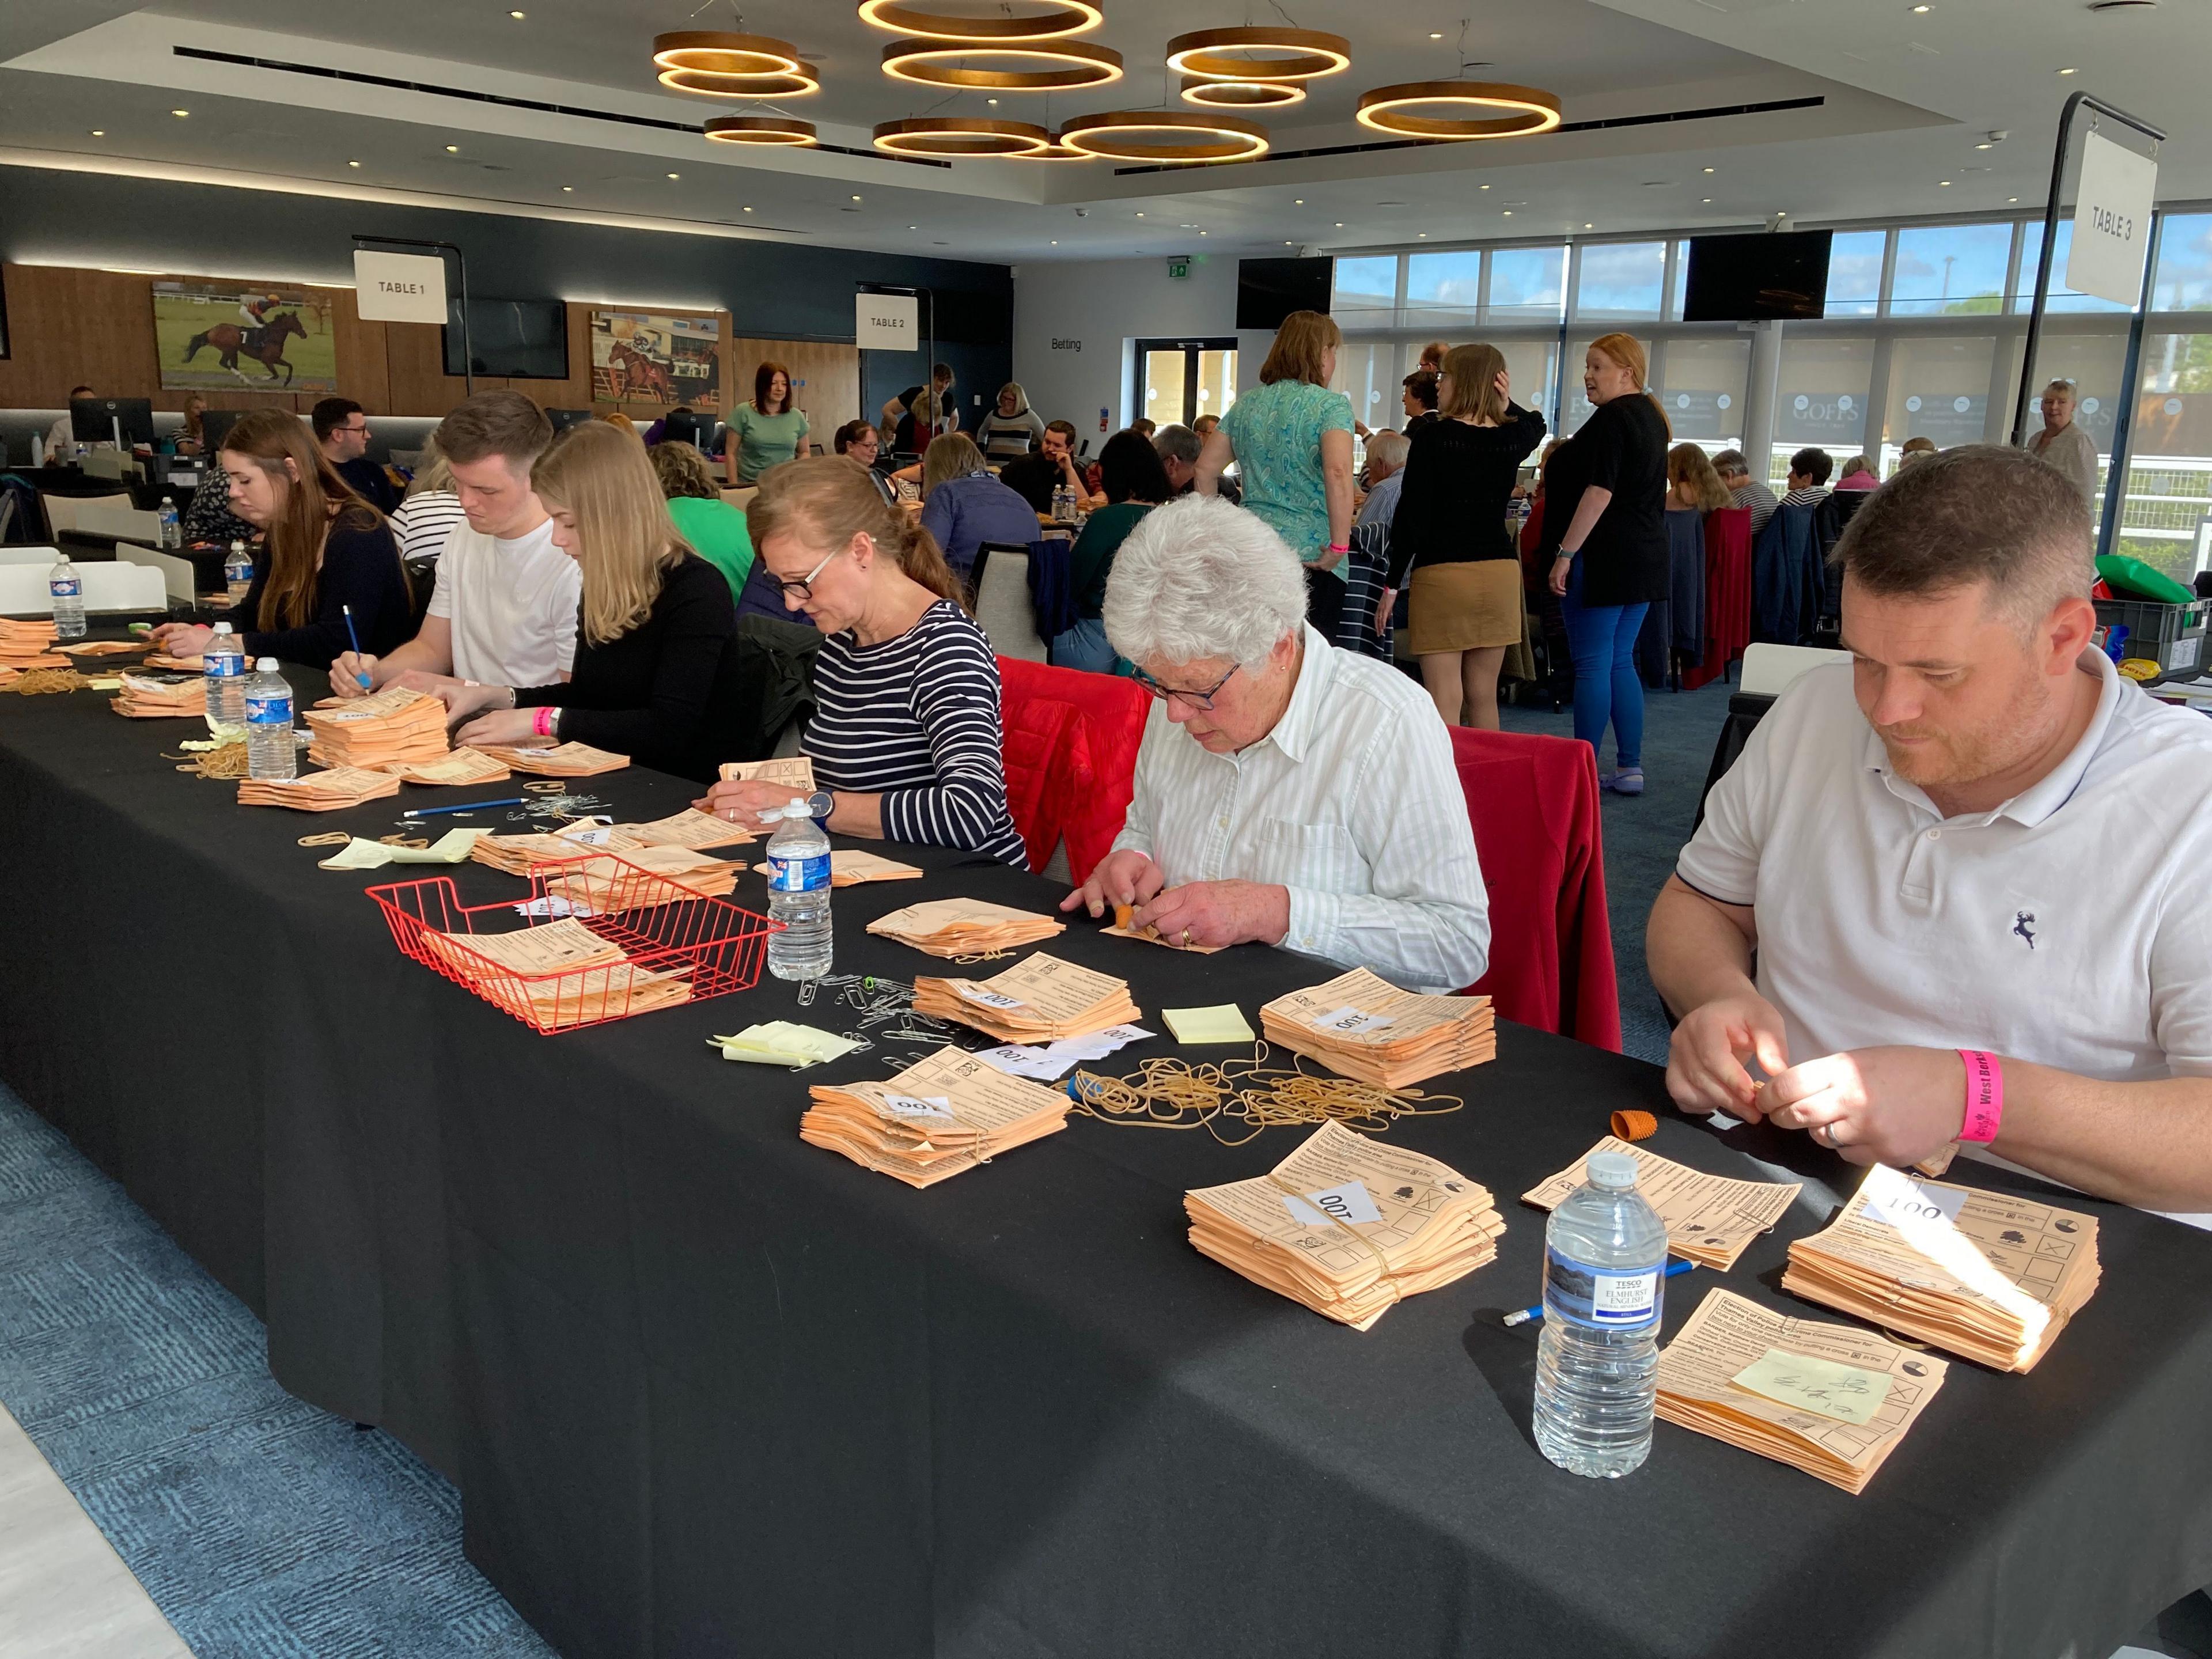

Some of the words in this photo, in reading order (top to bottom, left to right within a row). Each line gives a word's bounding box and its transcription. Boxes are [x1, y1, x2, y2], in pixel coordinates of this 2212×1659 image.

[2093, 206, 2123, 237] TABLE
[2125, 219, 2132, 240] 3
[378, 282, 416, 294] TABLE
[420, 285, 424, 294] 1
[871, 318, 897, 327] TABLE
[899, 319, 904, 327] 2
[1052, 338, 1081, 352] Betting
[984, 994, 1017, 1006] 100
[1103, 1029, 1134, 1039] 100
[995, 1050, 1030, 1062] 100
[1980, 1078, 1991, 1104] West
[1320, 1137, 1331, 1146] Vote
[1326, 1131, 1344, 1145] Thames
[1315, 1141, 1324, 1150] box
[1331, 1127, 1350, 1141] Election
[1392, 1152, 1425, 1164] Commissioner
[1319, 1195, 1353, 1218] 100
[1968, 1192, 2016, 1207] Commissioner
[1888, 1198, 1941, 1219] 100
[1861, 1222, 1889, 1235] Democrats
[1606, 1289, 1649, 1298] ELMHURST
[1611, 1296, 1643, 1305] ENGLISH
[1719, 1304, 1745, 1320] Thames
[1745, 1316, 1766, 1328] Valley
[1765, 1325, 1785, 1335] police
[1723, 1298, 1749, 1316] Election
[1758, 1316, 1778, 1328] Police
[1792, 1328, 1812, 1336] Crime
[1812, 1332, 1862, 1346] Commissioner
[1703, 1320, 1727, 1335] BARBER,
[1728, 1331, 1750, 1343] Matthew
[1749, 1339, 1767, 1348] David
[1710, 1314, 1723, 1324] box
[1722, 1320, 1737, 1330] next
[1744, 1328, 1758, 1338] your
[1758, 1334, 1779, 1344] choice
[1714, 1309, 1730, 1320] Vote
[1729, 1315, 1738, 1323] for
[1737, 1319, 1751, 1330] only
[1763, 1331, 1796, 1344] candidate
[1803, 1342, 1825, 1351] putting
[1831, 1348, 1850, 1357] cross
[1869, 1355, 1882, 1363] the
[1692, 1333, 1728, 1349] Conservative
